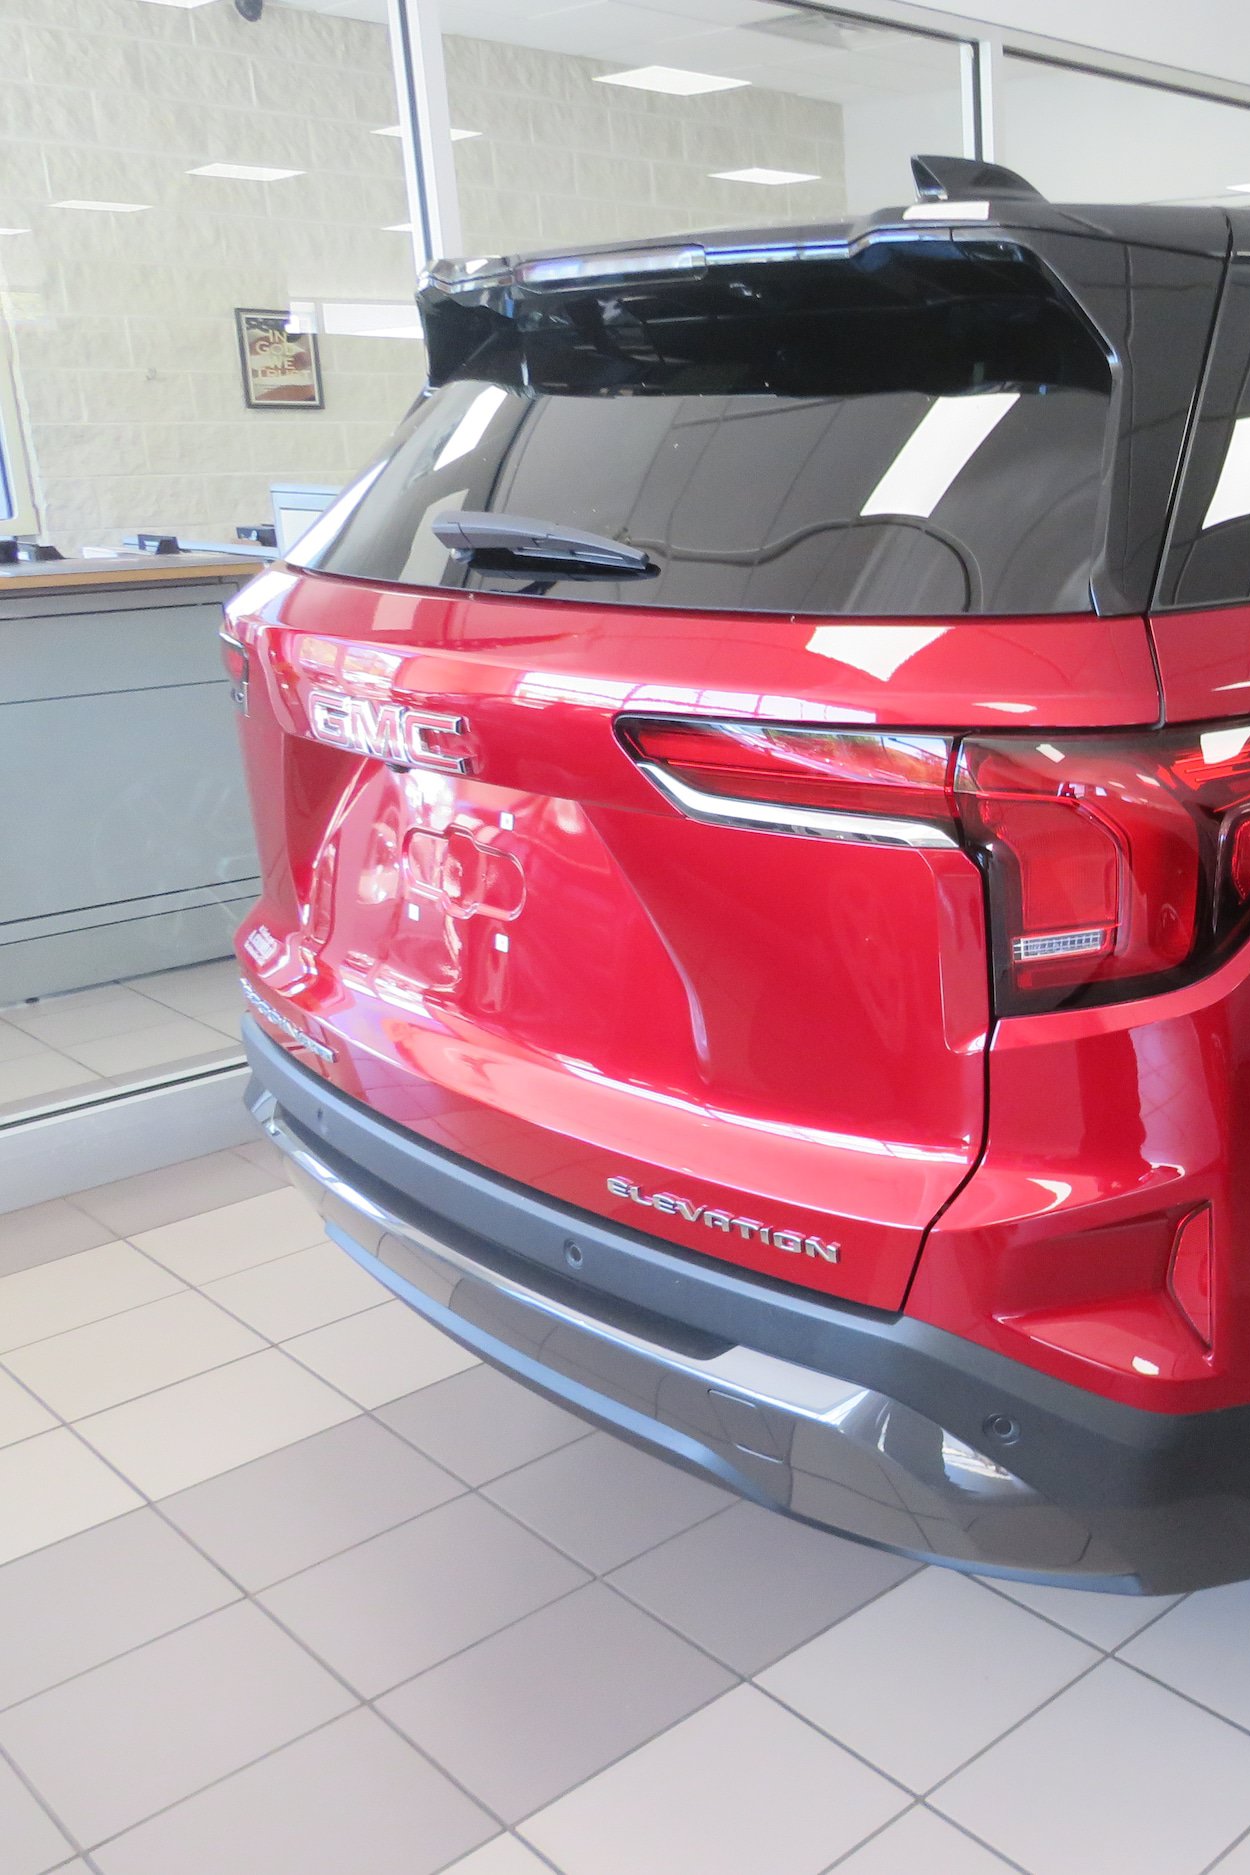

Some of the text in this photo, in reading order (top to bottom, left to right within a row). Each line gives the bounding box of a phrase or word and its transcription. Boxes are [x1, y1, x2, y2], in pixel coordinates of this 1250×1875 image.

[268, 329, 288, 343] IN
[308, 690, 469, 776] GMC
[606, 1176, 841, 1264] ELEVATION
